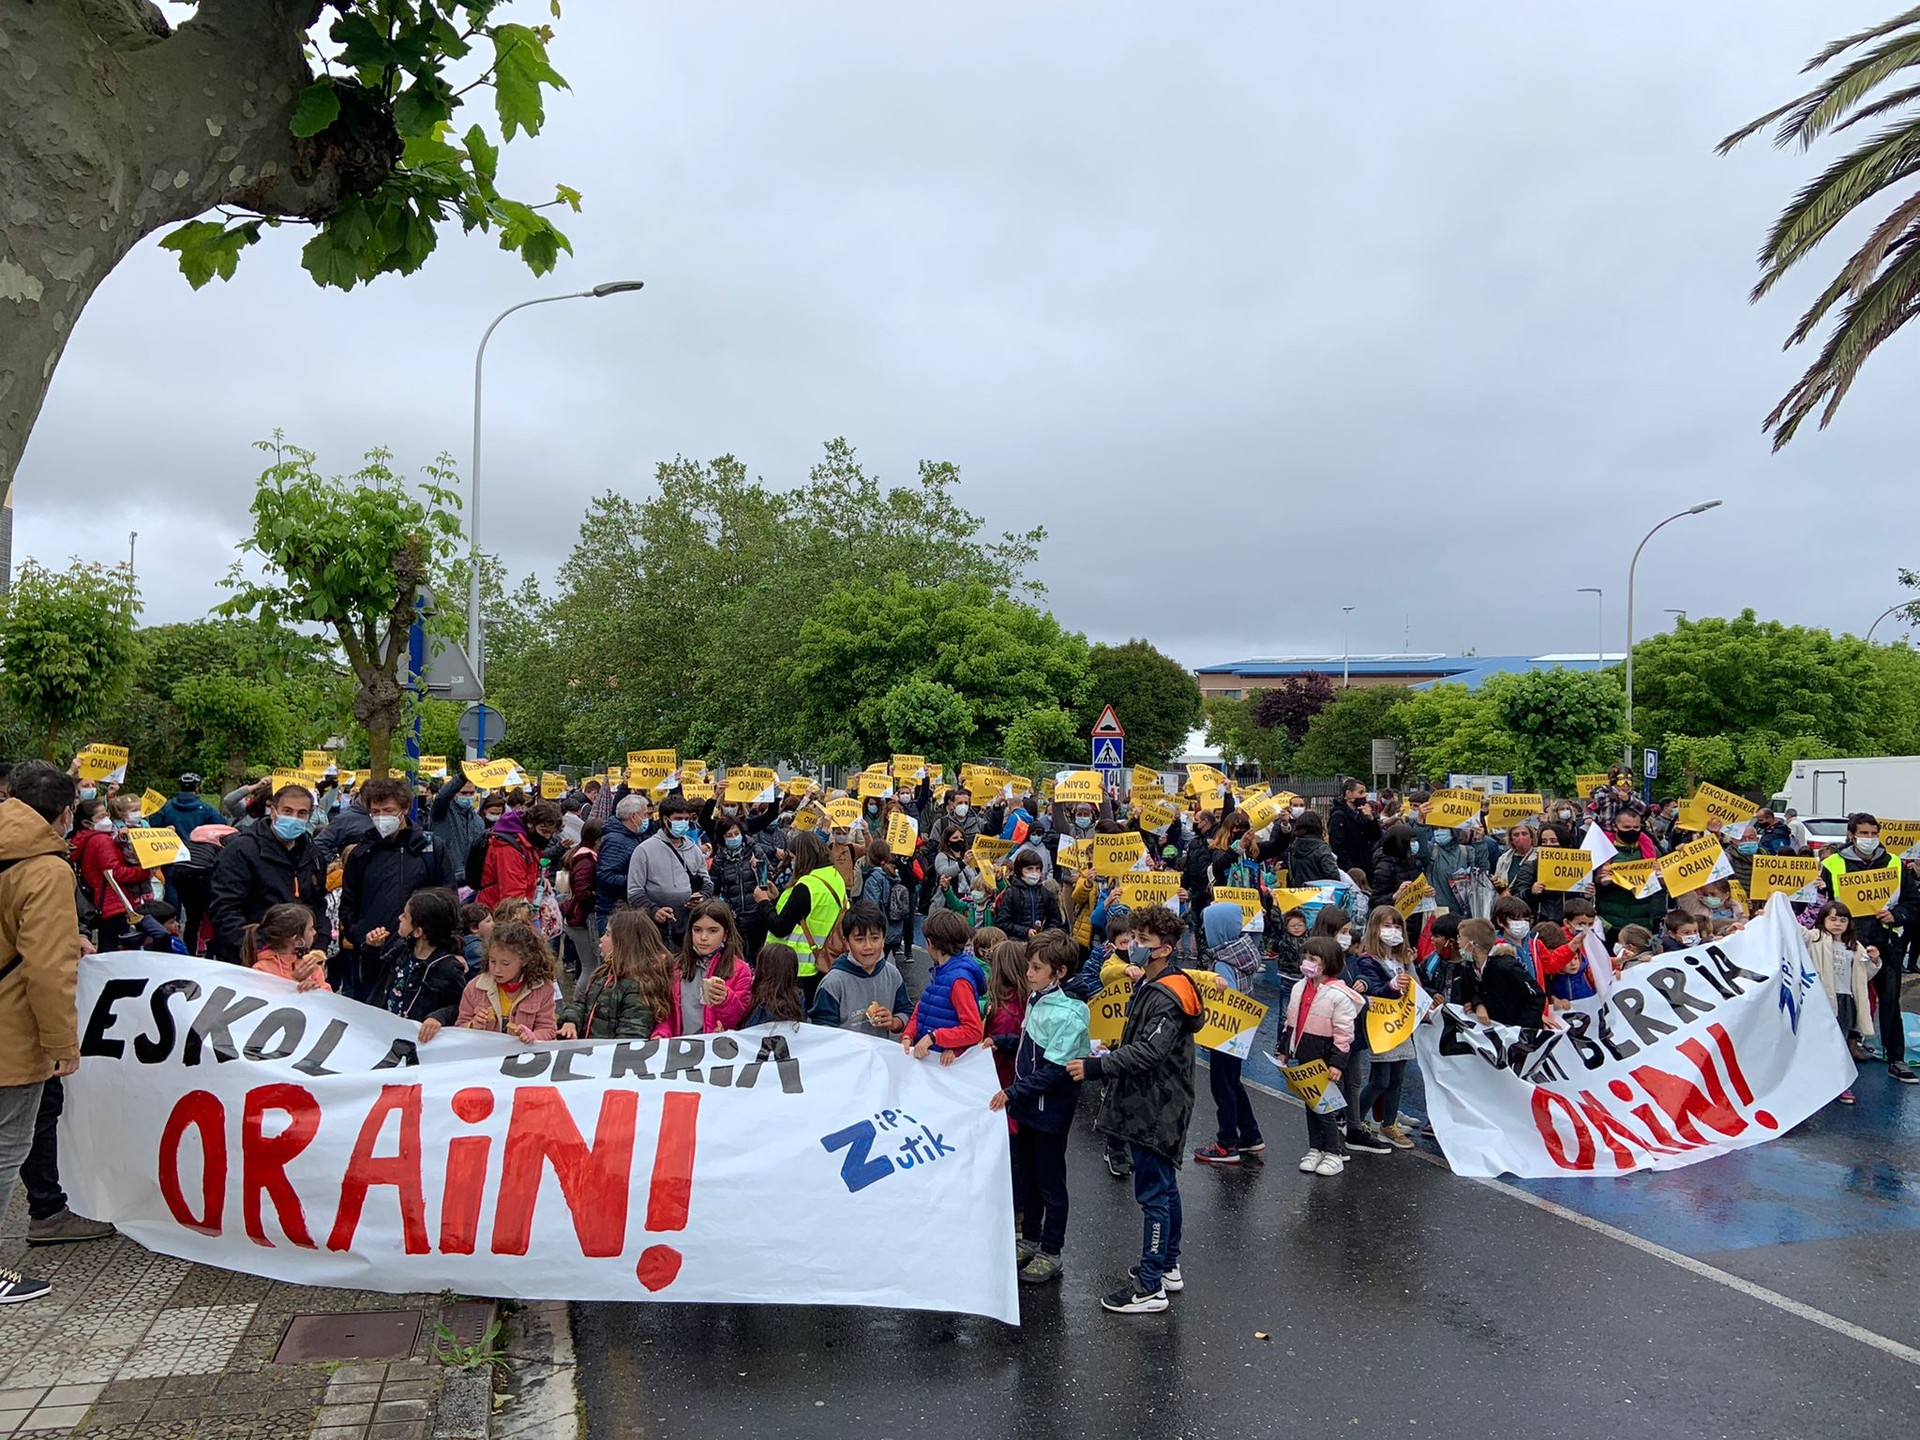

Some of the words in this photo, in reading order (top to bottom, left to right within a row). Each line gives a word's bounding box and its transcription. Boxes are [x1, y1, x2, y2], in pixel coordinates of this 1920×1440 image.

[91, 758, 118, 770] ORAIN
[480, 766, 508, 778] ORAIN
[642, 768, 668, 777] ORAIN
[728, 770, 752, 778] ESKOLA
[753, 770, 772, 778] BERRIA
[738, 782, 764, 792] ORAIN
[1064, 780, 1090, 790] ORAIN
[1492, 796, 1517, 804] ESKOLA
[1520, 796, 1542, 805] BERRIA
[1700, 786, 1729, 804] ESKOLA
[1730, 797, 1756, 814] BERRIA
[835, 810, 858, 818] ORAIN
[1442, 803, 1472, 816] ORAIN
[1503, 809, 1534, 818] ORAIN
[1706, 803, 1738, 822] ORAIN
[1144, 814, 1165, 826] ORAIN
[1878, 821, 1902, 831] SKOLA
[132, 831, 156, 840] ESKOLA
[898, 822, 909, 844] ORAIN
[150, 842, 179, 852] ORAIN
[1096, 837, 1125, 846] ESKOLA
[1886, 836, 1914, 846] ORAIN
[1110, 850, 1139, 862] ORAIN
[1540, 850, 1568, 860] ESKOLA
[1570, 852, 1592, 860] BERRIA
[1661, 850, 1689, 869] ESKOLA
[1688, 838, 1718, 855] BERRIA
[1678, 855, 1714, 878] ORAIN
[1756, 858, 1788, 869] ESKOLA
[1790, 860, 1816, 870] BERRIA
[1554, 866, 1584, 878] ORAIN
[1840, 874, 1872, 886] ESKOLA
[1873, 870, 1898, 882] BERRIA
[1122, 874, 1150, 884] ESKOLA
[1152, 875, 1180, 884] BERRIA
[1623, 875, 1646, 886] AIN
[1768, 874, 1805, 887] ORAIN
[1134, 890, 1167, 902] ORAIN
[1856, 887, 1890, 902] ORAIN
[1242, 906, 1254, 917] AIN
[1228, 994, 1262, 1018] BERRIA
[1204, 1008, 1241, 1034] ORAIN
[1384, 1000, 1416, 1034] ORAIN
[80, 978, 420, 1076] ESKOLA
[1290, 1063, 1327, 1082] BERRIA
[157, 1083, 702, 1293] ORAiN!
